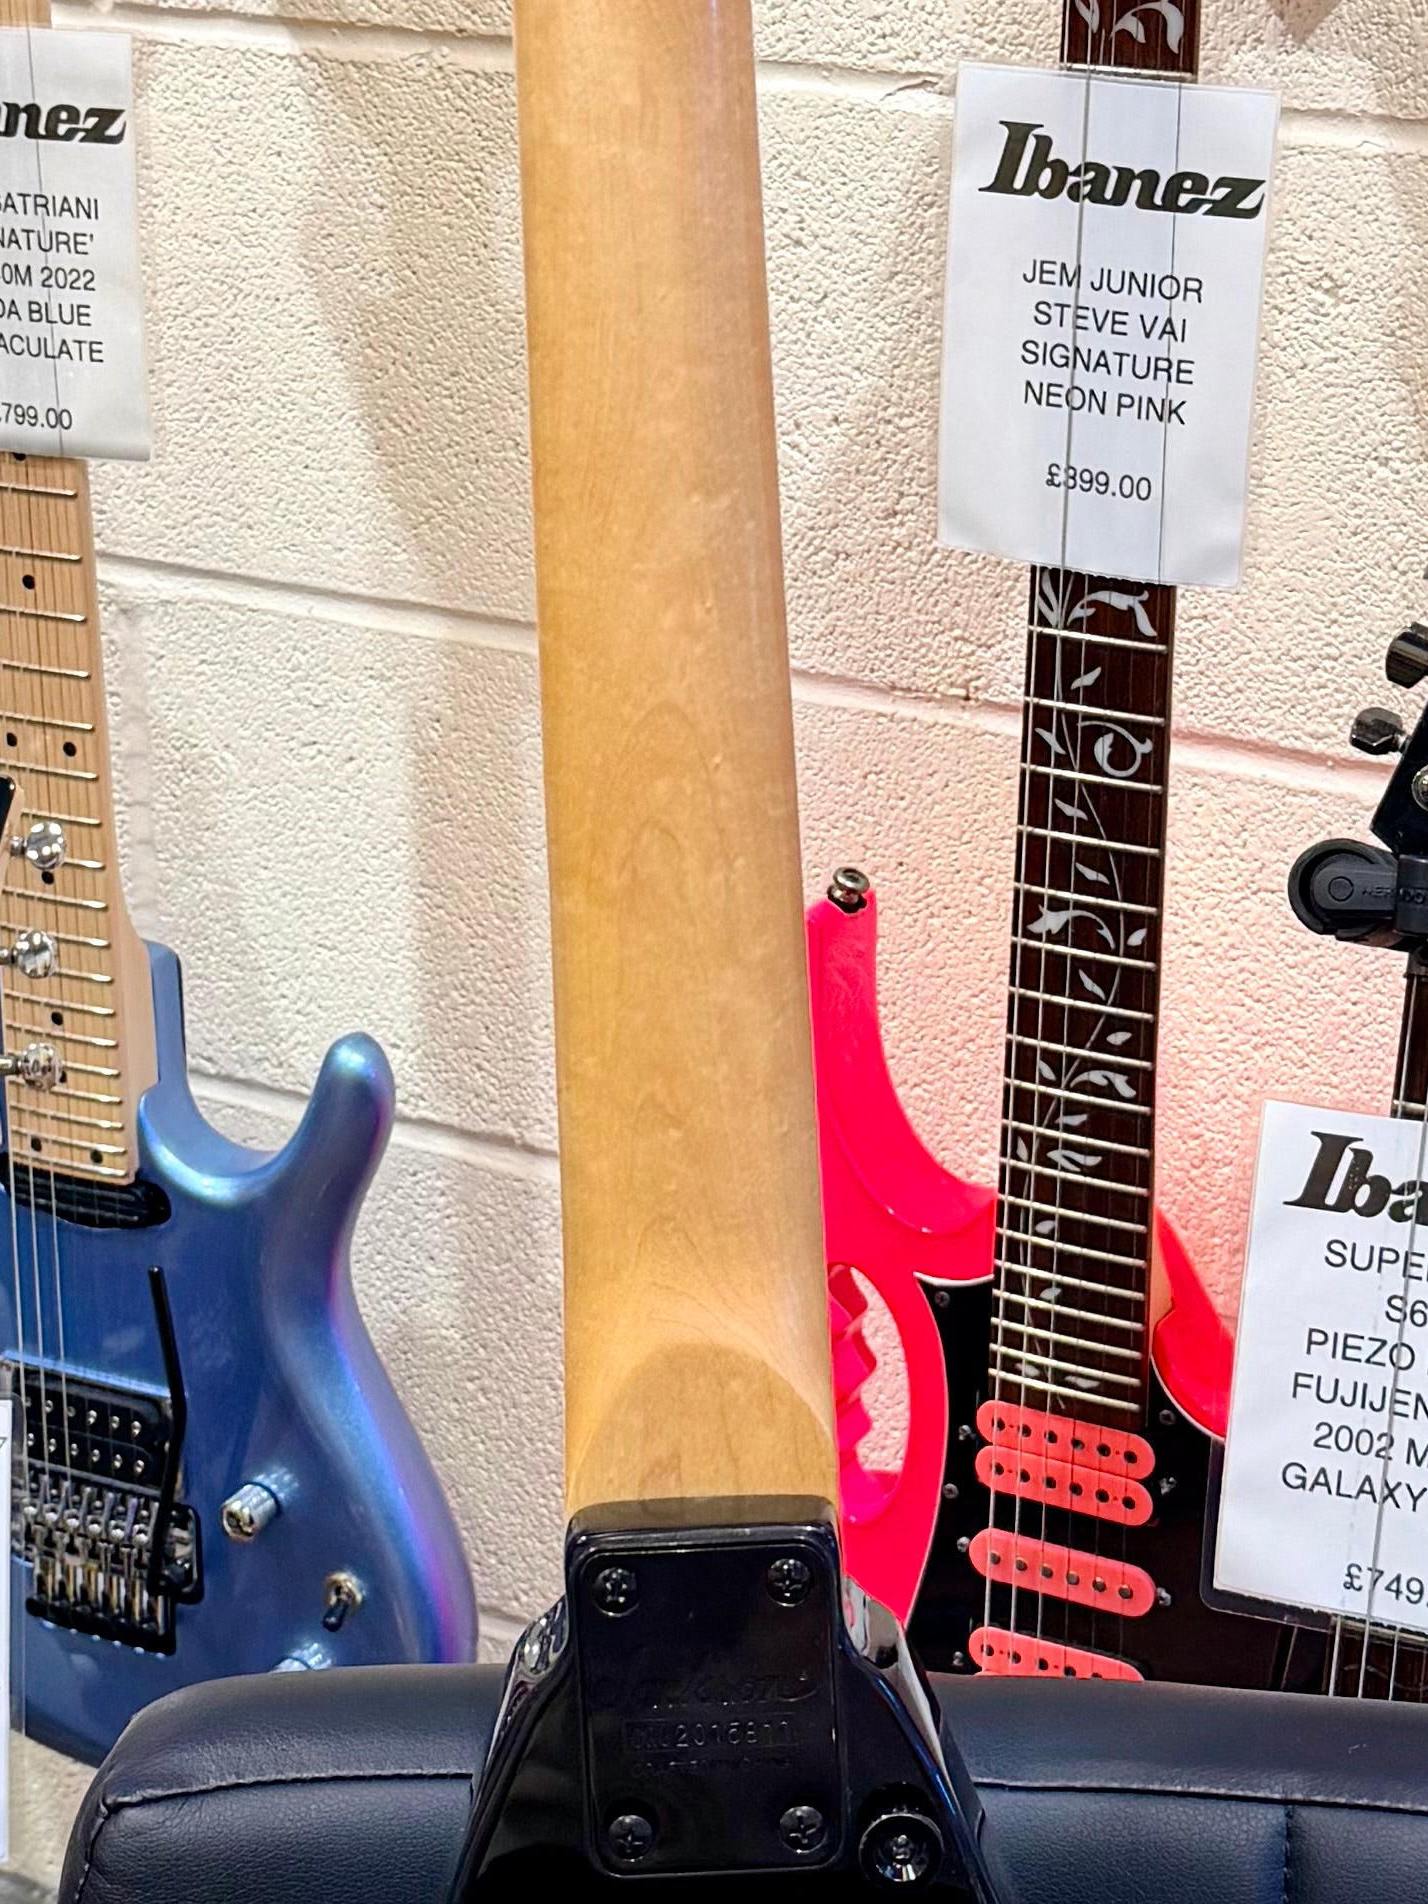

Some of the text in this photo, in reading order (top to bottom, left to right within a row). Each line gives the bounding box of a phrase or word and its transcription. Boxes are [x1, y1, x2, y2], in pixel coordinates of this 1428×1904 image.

[978, 119, 1267, 221] Ibanez
[40, 264, 97, 293] 2022
[1022, 259, 1205, 304] JEM JUNIOR
[27, 299, 92, 327] BLUE
[1033, 301, 1187, 344] STEVE VAI
[1020, 340, 1196, 387] SIGNATURE
[1024, 380, 1187, 426] NEON PINK
[1045, 462, 1152, 501] £399.00
[1305, 1327, 1417, 1373] PIEZO
[1313, 1421, 1395, 1462] 2002
[1281, 1461, 1428, 1513] GALAXY
